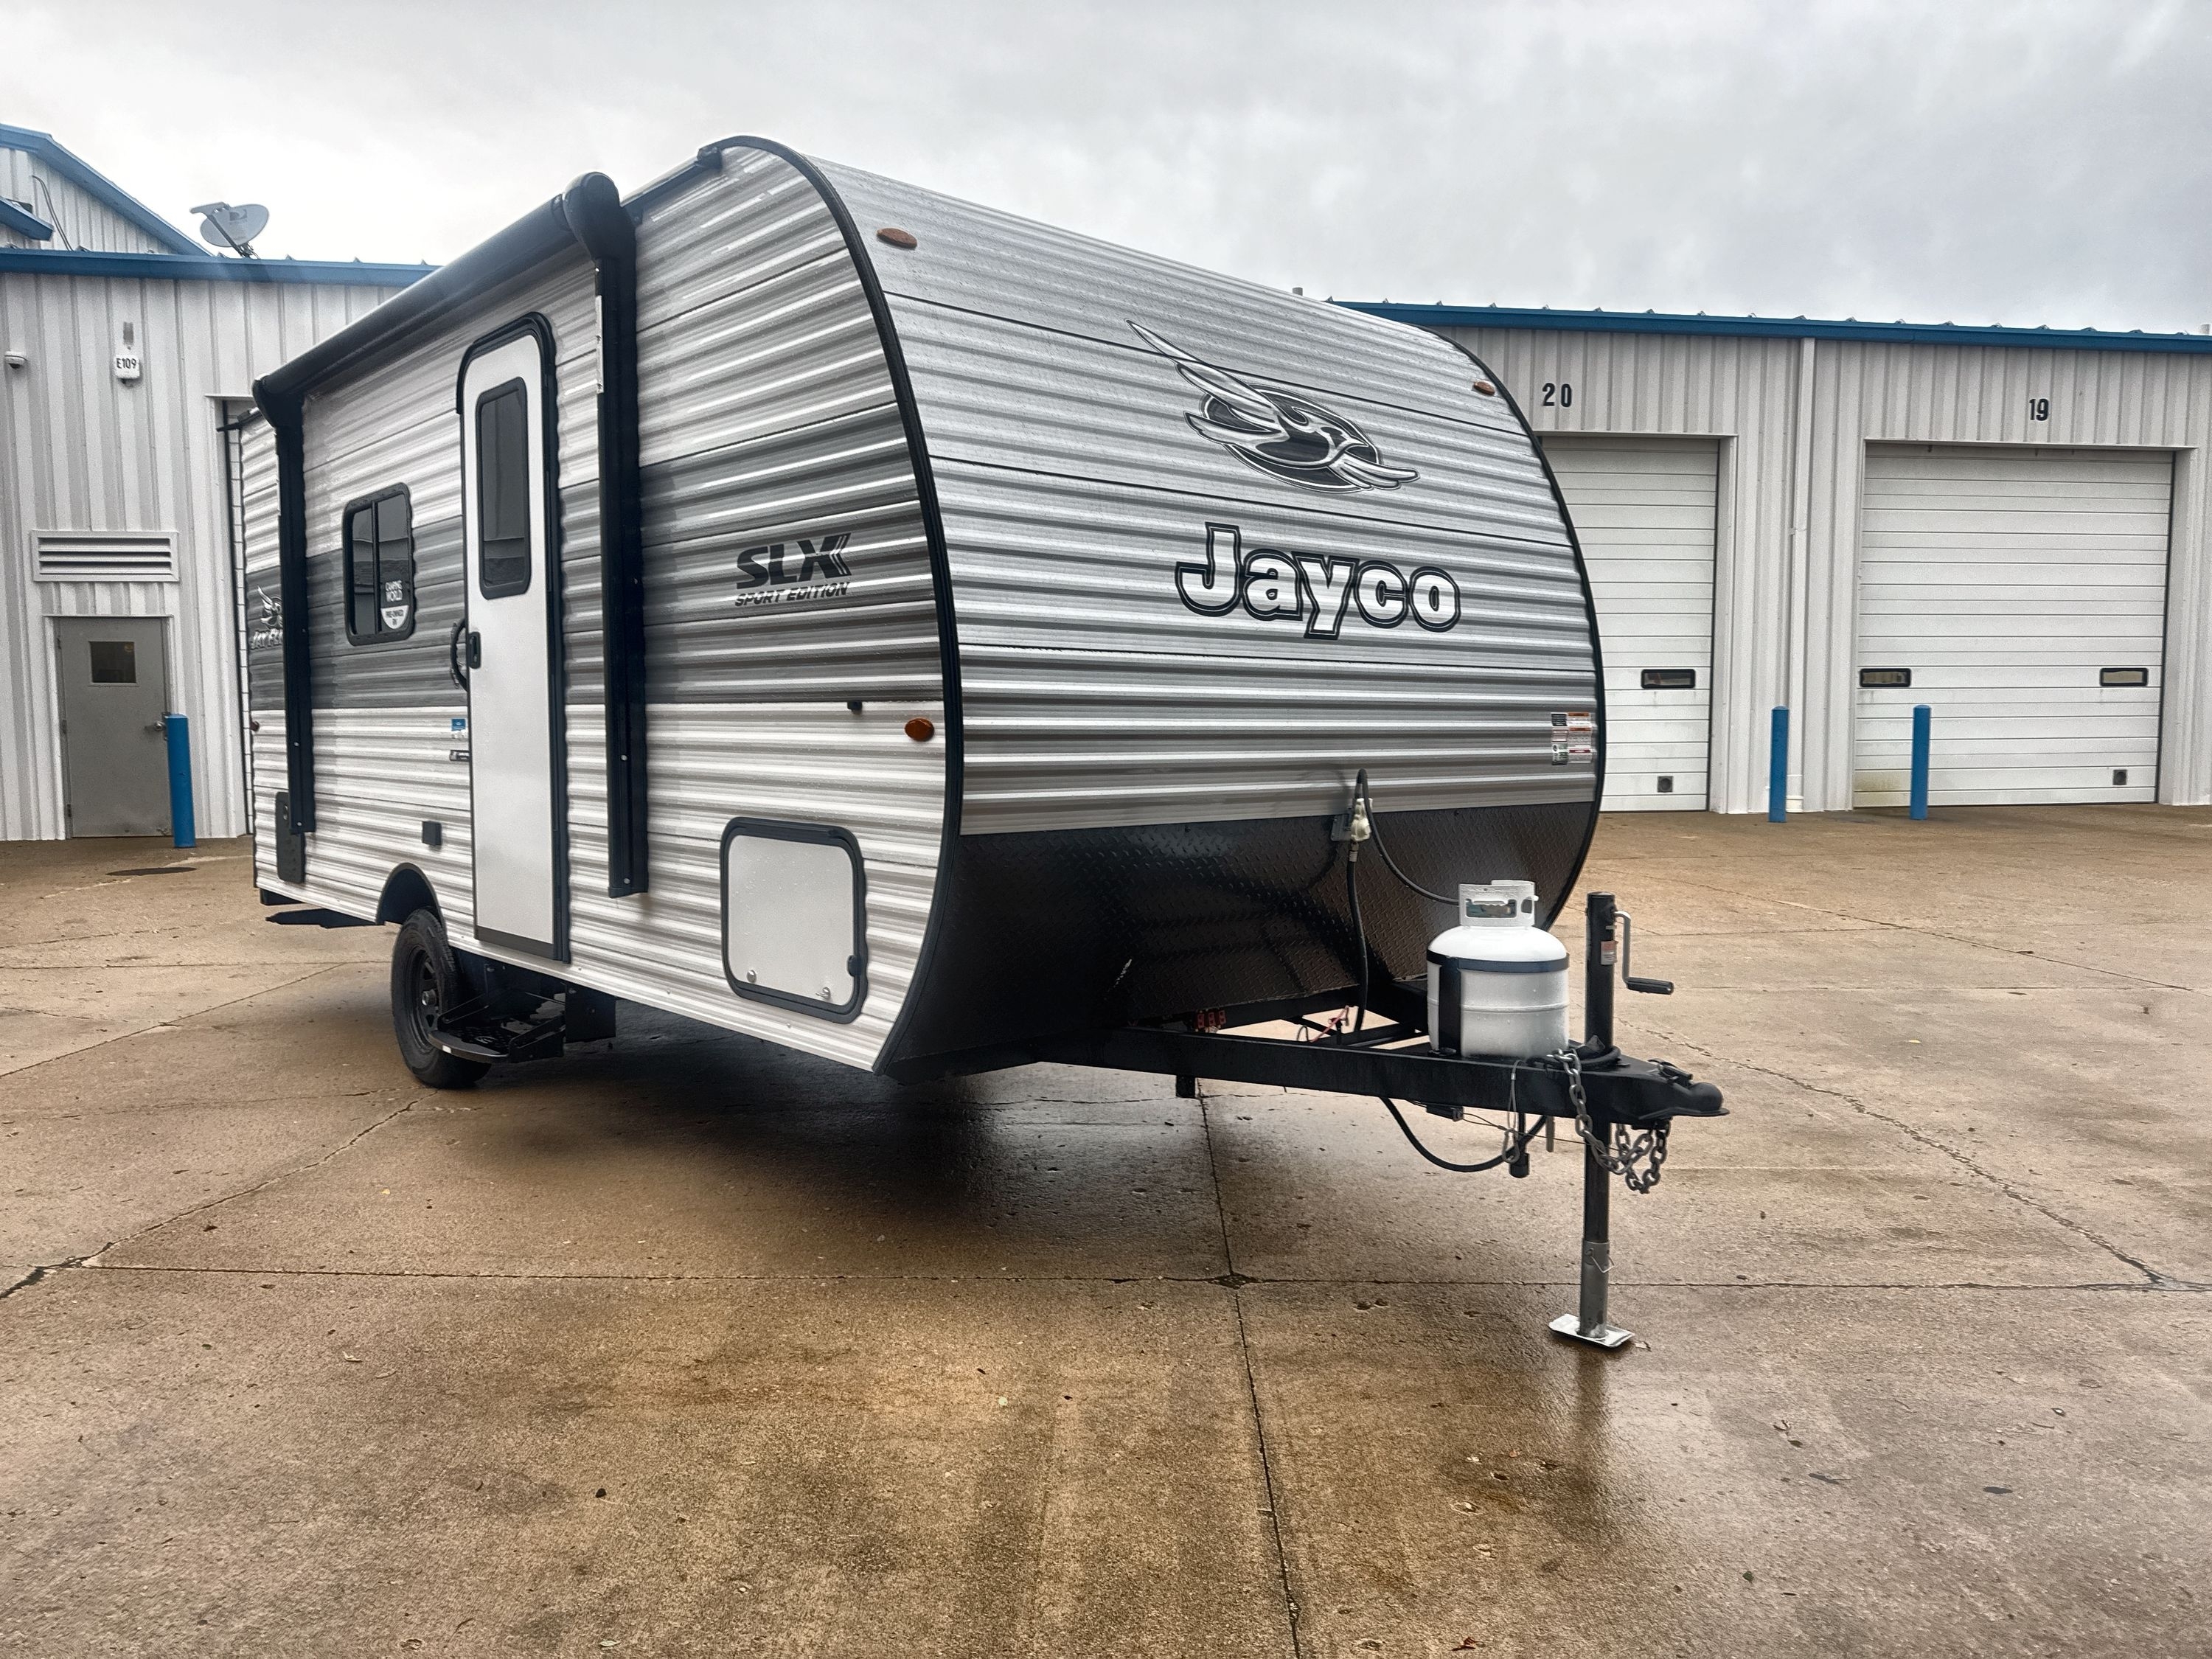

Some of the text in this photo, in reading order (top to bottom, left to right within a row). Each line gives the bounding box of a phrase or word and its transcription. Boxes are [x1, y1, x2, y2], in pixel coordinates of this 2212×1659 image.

[116, 358, 137, 369] E109
[1542, 382, 1572, 407] 20
[2028, 398, 2049, 421] 19
[736, 532, 852, 589] SLX
[1175, 521, 1461, 640] Jayco
[734, 582, 850, 606] SPORT EDITION
